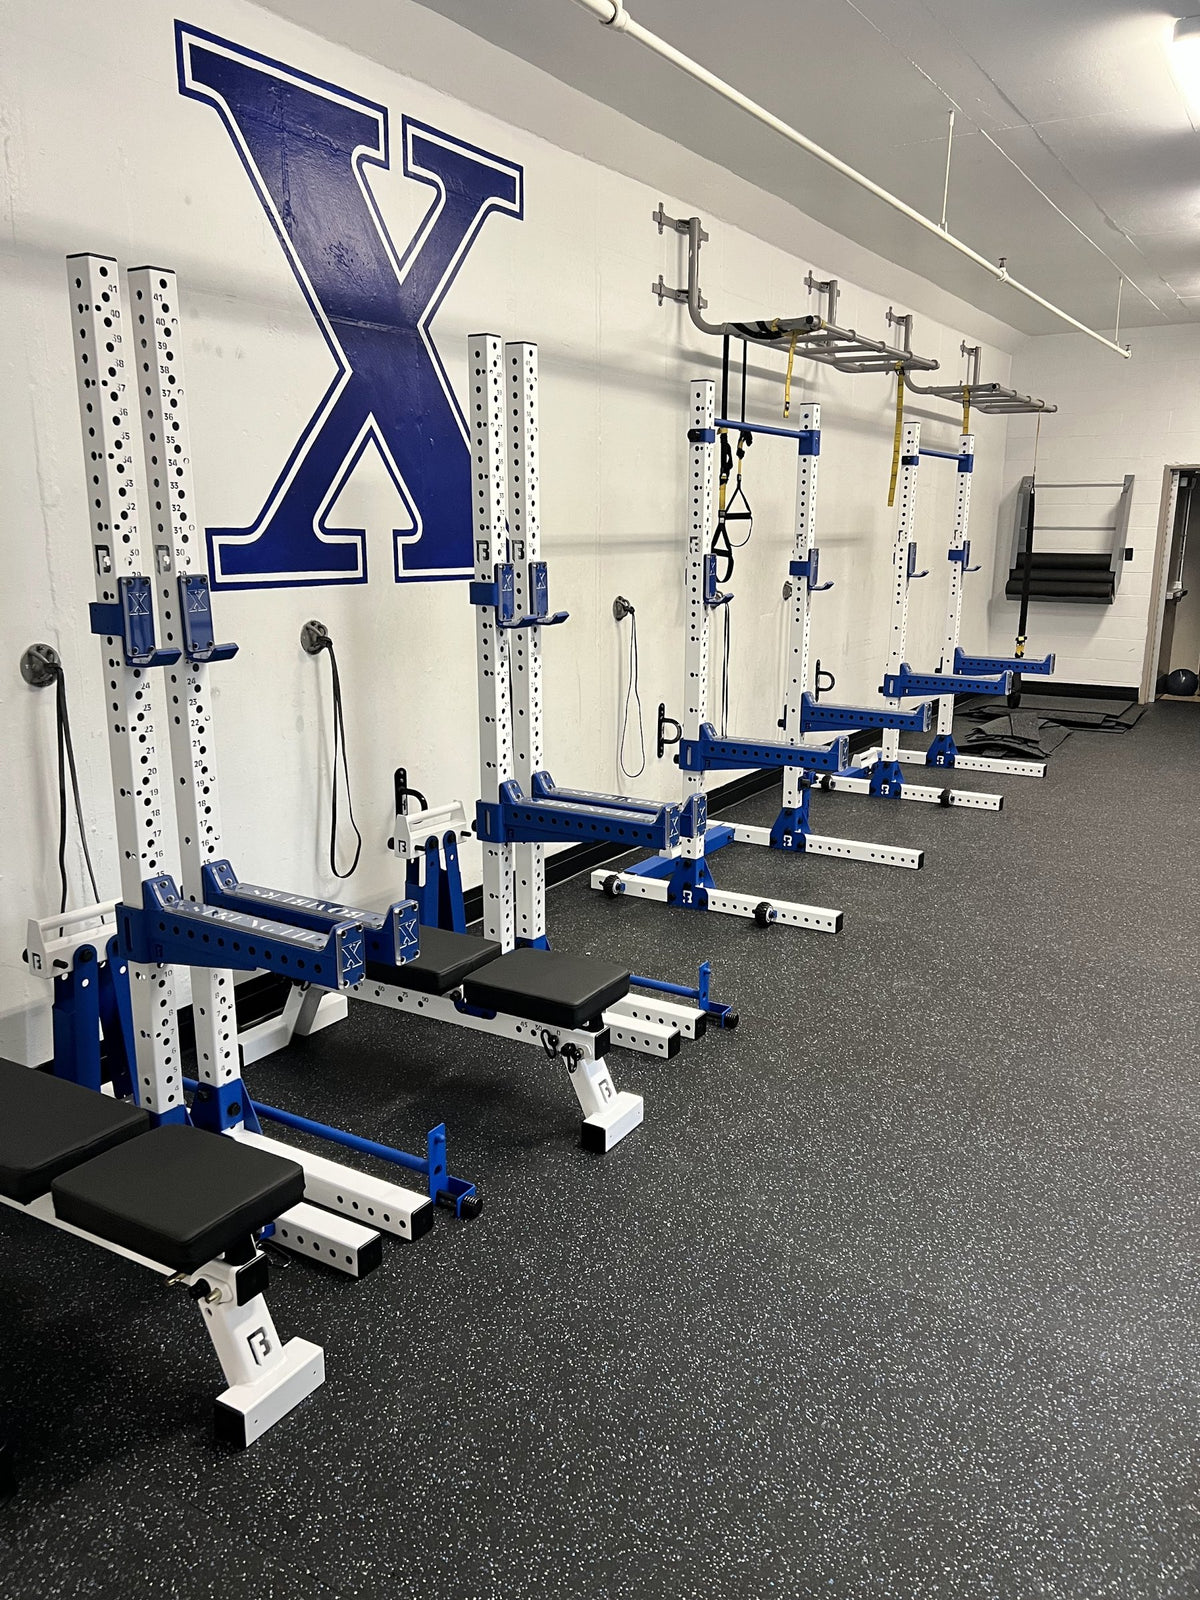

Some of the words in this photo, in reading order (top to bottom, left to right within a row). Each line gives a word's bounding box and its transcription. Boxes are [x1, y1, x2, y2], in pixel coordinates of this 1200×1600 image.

[108, 285, 117, 293] 41
[154, 294, 163, 302] 41
[174, 19, 523, 591] X
[110, 310, 120, 318] 40
[156, 318, 166, 326] 40
[157, 342, 167, 350] 39
[160, 366, 170, 374] 38
[162, 389, 171, 397] 37
[172, 504, 181, 512] 32
[128, 592, 149, 615] X
[187, 589, 207, 612] X
[187, 677, 196, 685] 24
[189, 698, 198, 706] 23
[191, 719, 200, 727] 22
[192, 739, 201, 747] 21
[194, 759, 203, 767] 20
[201, 839, 210, 847] 16
[398, 919, 417, 949] X
[341, 940, 363, 972] X
